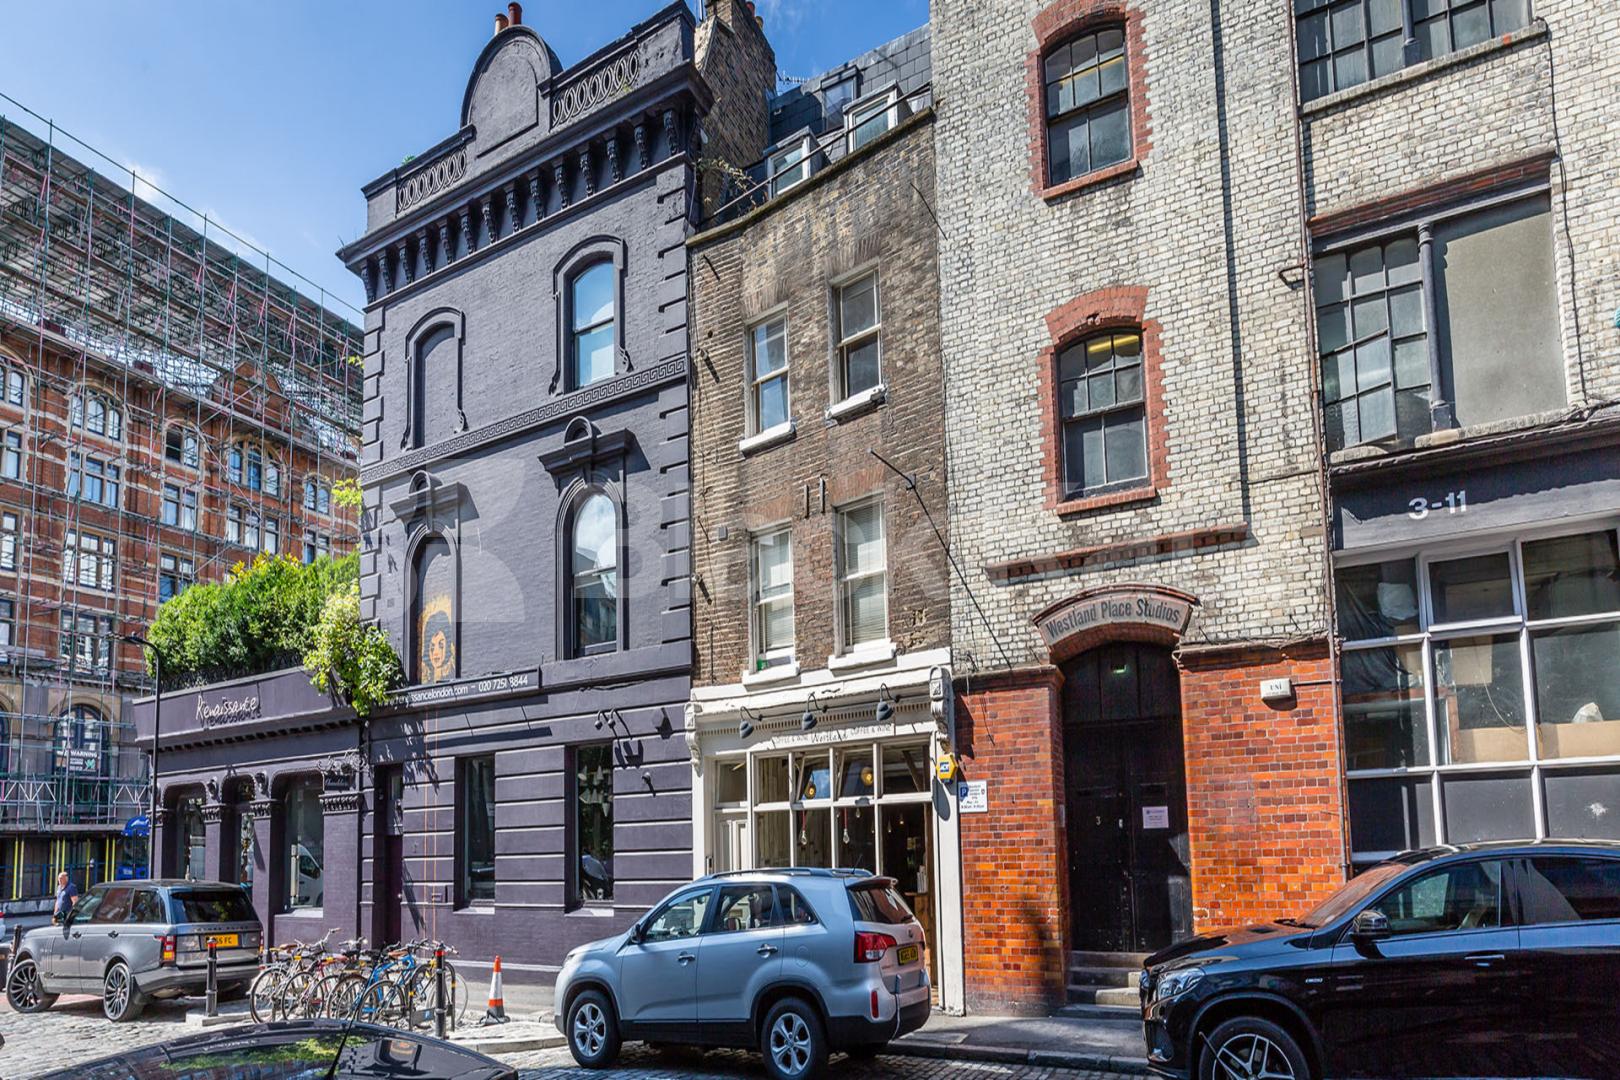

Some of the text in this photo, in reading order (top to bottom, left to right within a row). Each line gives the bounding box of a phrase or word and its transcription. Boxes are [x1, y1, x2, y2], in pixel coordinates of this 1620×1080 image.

[1408, 490, 1467, 520] 3-11
[1046, 598, 1180, 639] Westland Place Studios
[478, 680, 492, 692] 020
[492, 678, 508, 690] 7251
[509, 674, 528, 688] 8844
